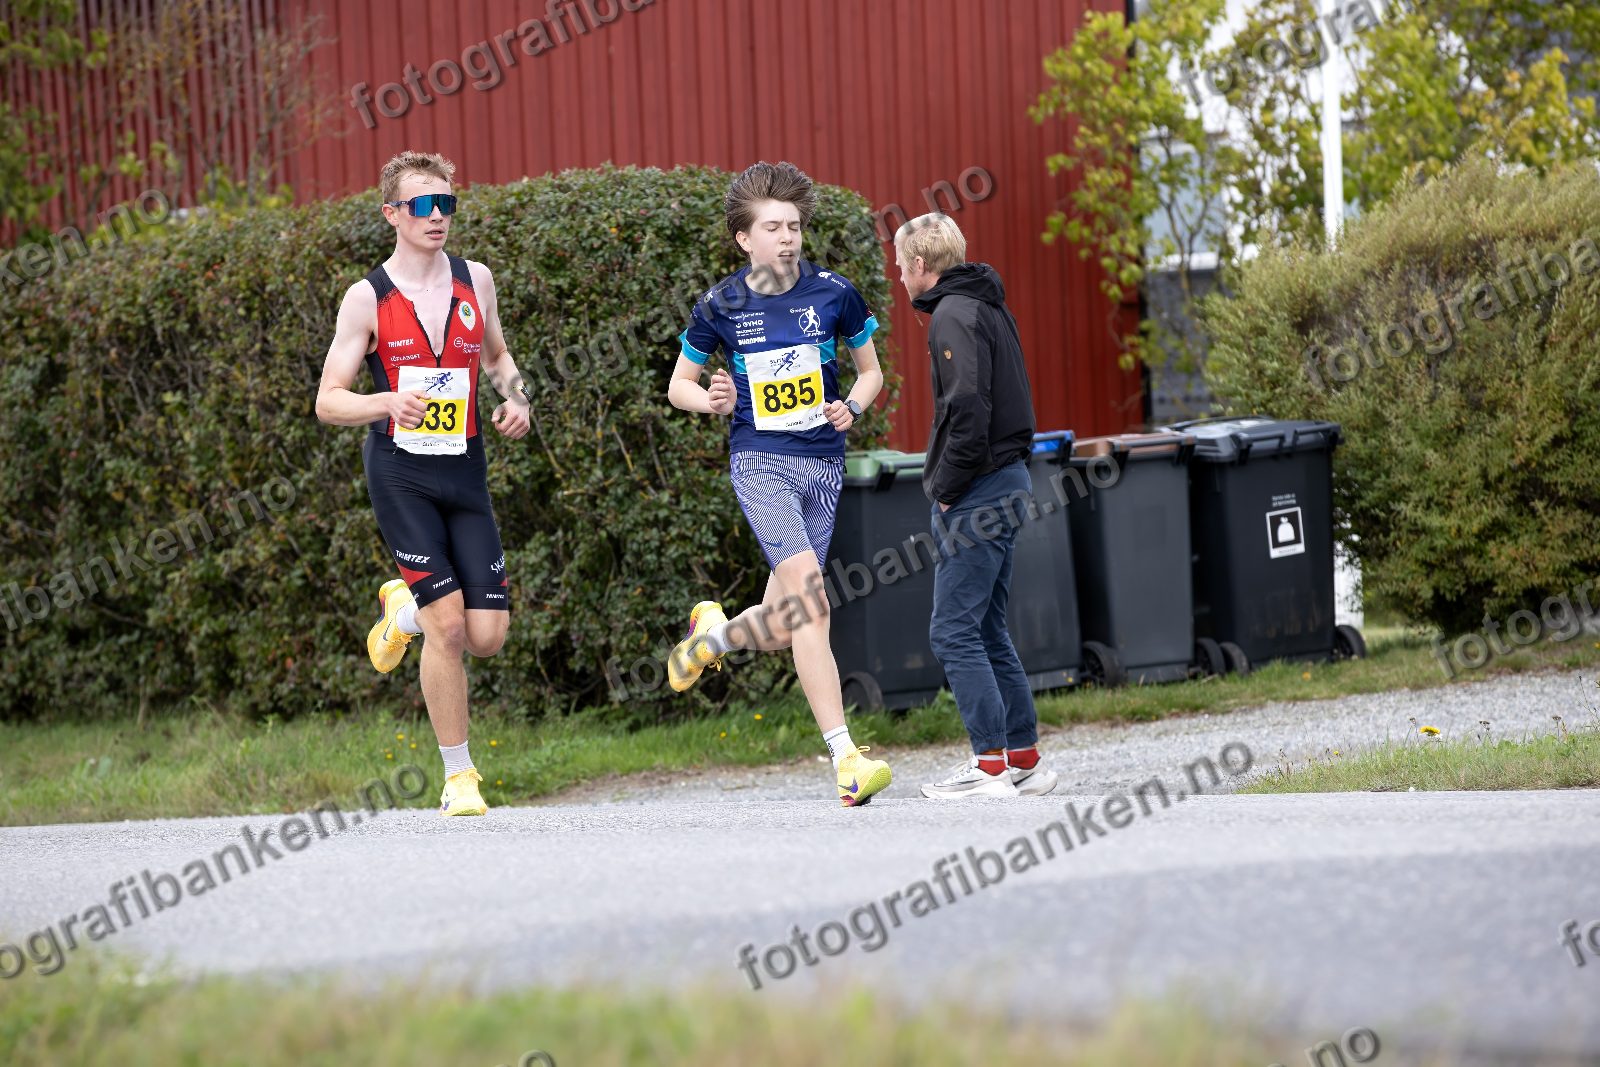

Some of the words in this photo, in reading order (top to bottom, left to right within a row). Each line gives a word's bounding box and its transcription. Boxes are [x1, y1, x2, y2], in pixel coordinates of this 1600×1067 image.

[388, 338, 414, 348] TRIMTEX
[763, 376, 816, 413] 835
[415, 401, 457, 431] 33
[395, 549, 431, 564] TRIMTEX
[432, 576, 453, 590] TRIMTEX
